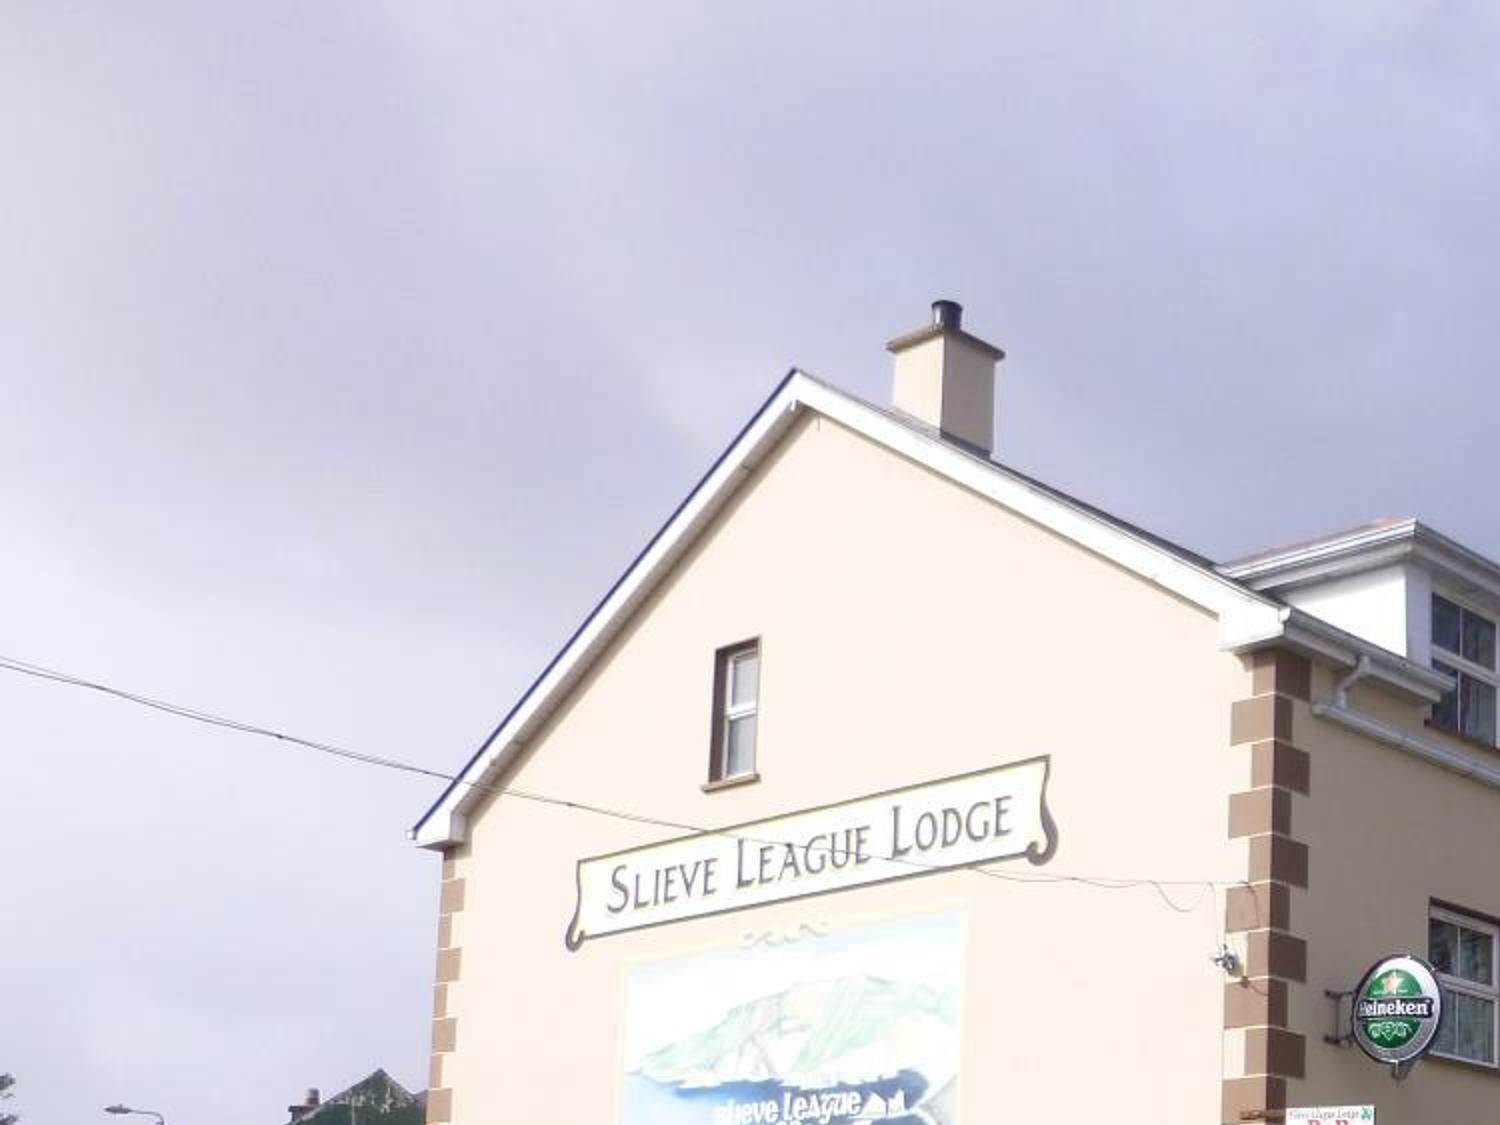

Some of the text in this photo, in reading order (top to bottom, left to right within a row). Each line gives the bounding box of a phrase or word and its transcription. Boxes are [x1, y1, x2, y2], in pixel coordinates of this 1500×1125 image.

[606, 796, 1013, 914] SLIEVE LEAGUE LODGE
[1359, 999, 1429, 1016] Heineken
